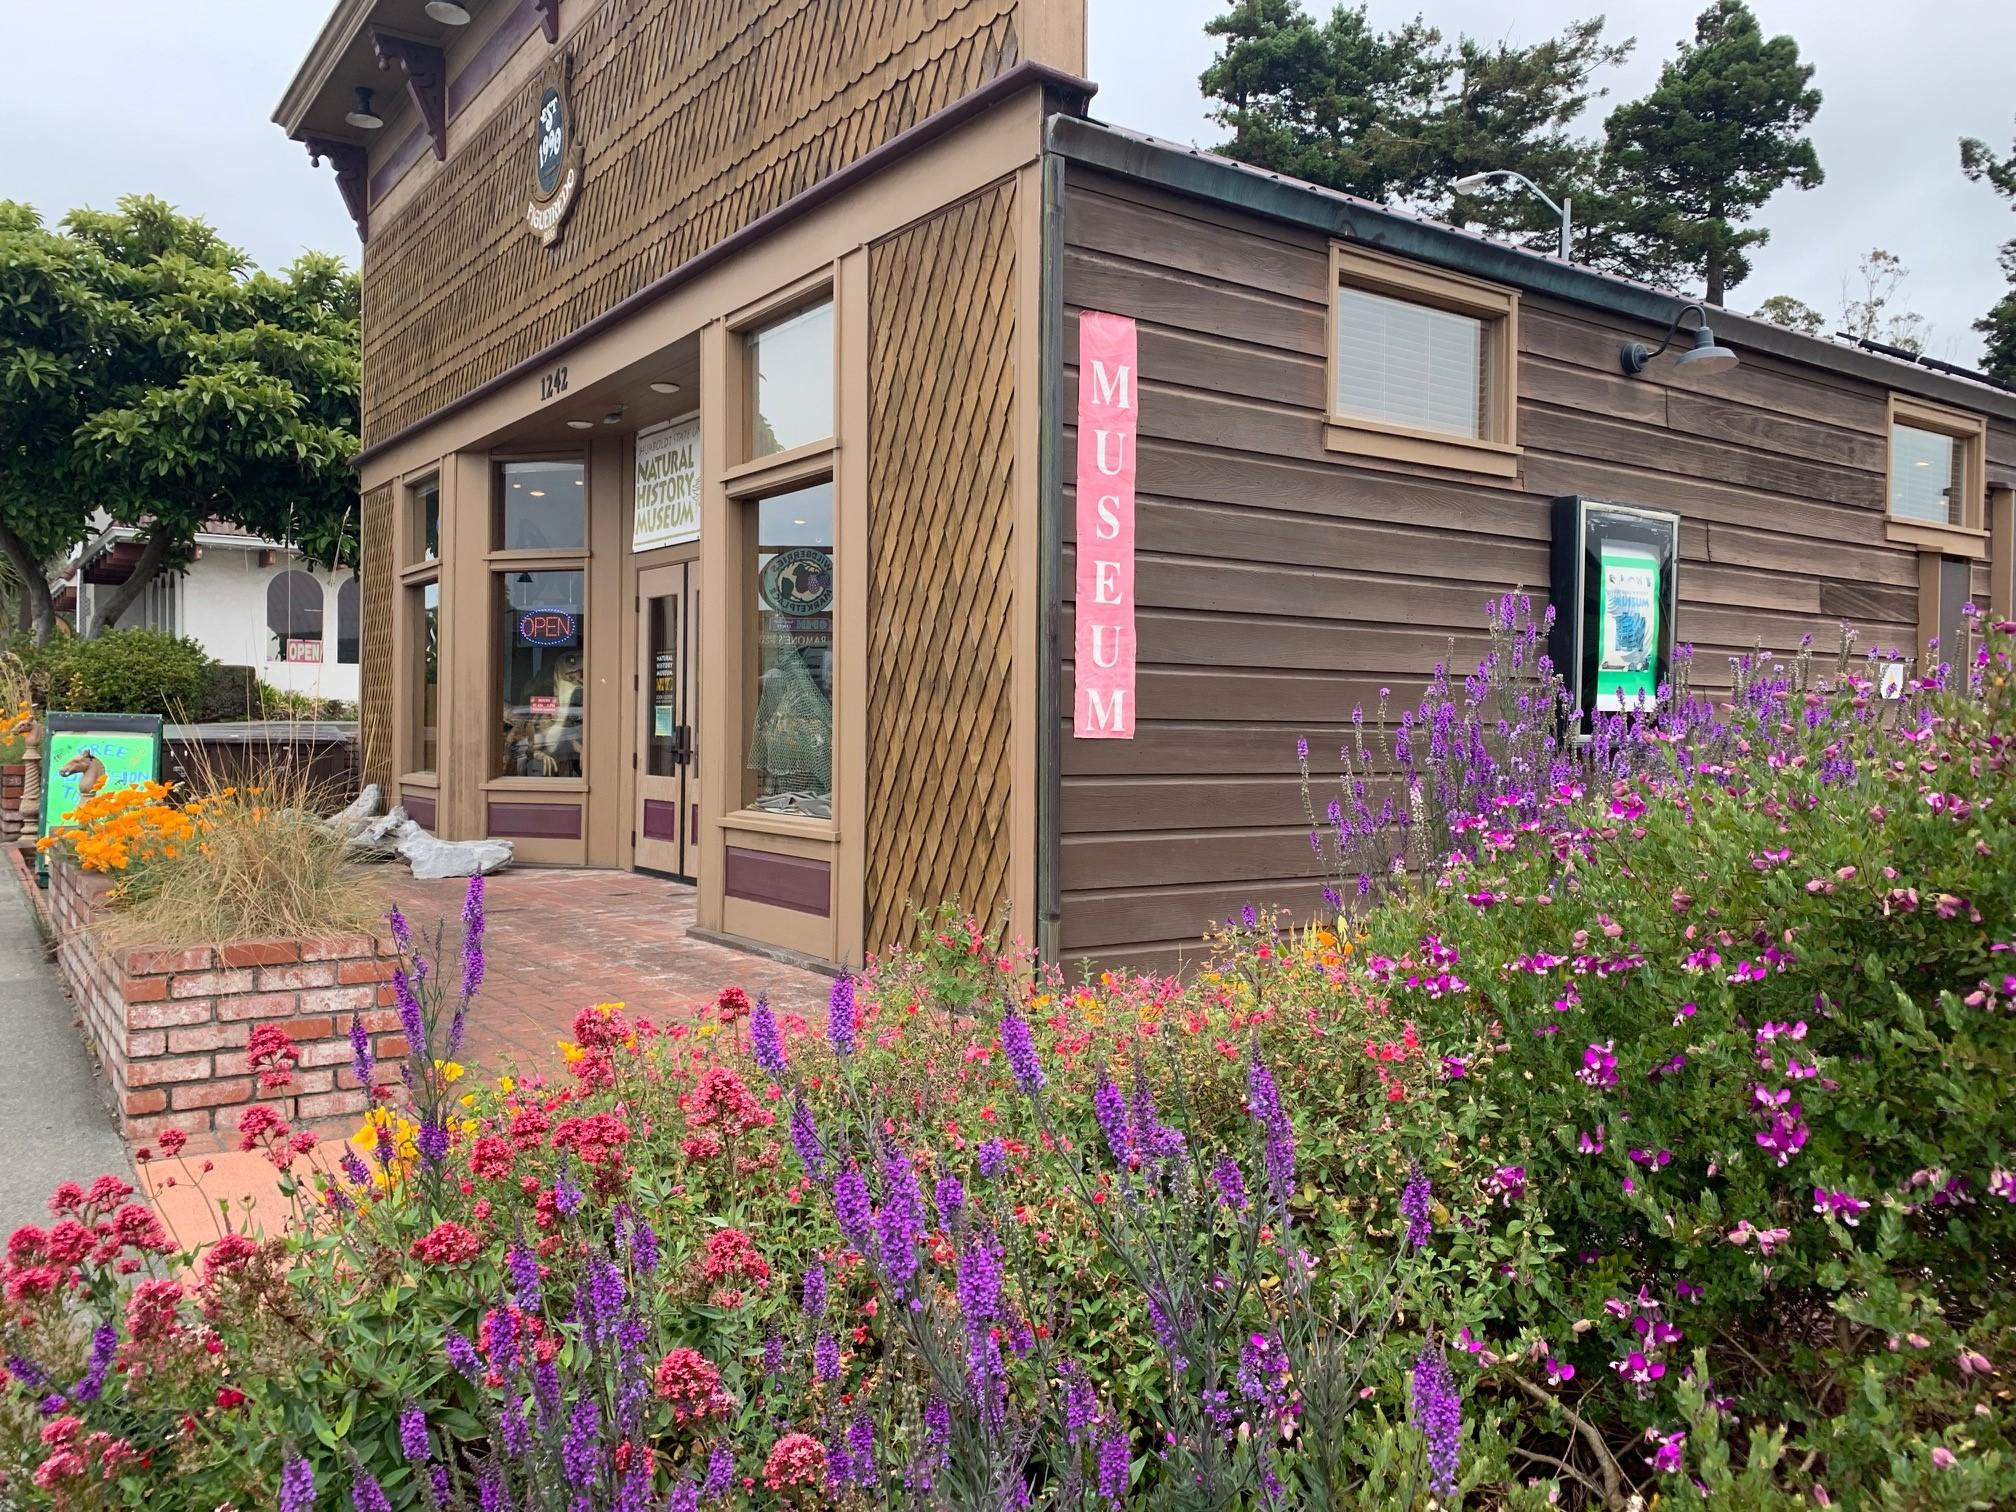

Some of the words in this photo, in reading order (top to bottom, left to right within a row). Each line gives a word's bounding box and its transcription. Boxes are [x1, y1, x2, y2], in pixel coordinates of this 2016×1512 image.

[540, 97, 558, 132] EST
[538, 127, 562, 169] 1990
[526, 168, 575, 231] FIGUEIREDO
[541, 366, 568, 401] 1242
[637, 443, 695, 484] NATURAL
[637, 470, 695, 510] HISTORY
[636, 502, 694, 535] MUSEUM
[1086, 360, 1131, 732] MUSEUM
[522, 616, 570, 637] OPEN
[289, 642, 321, 661] OPEN
